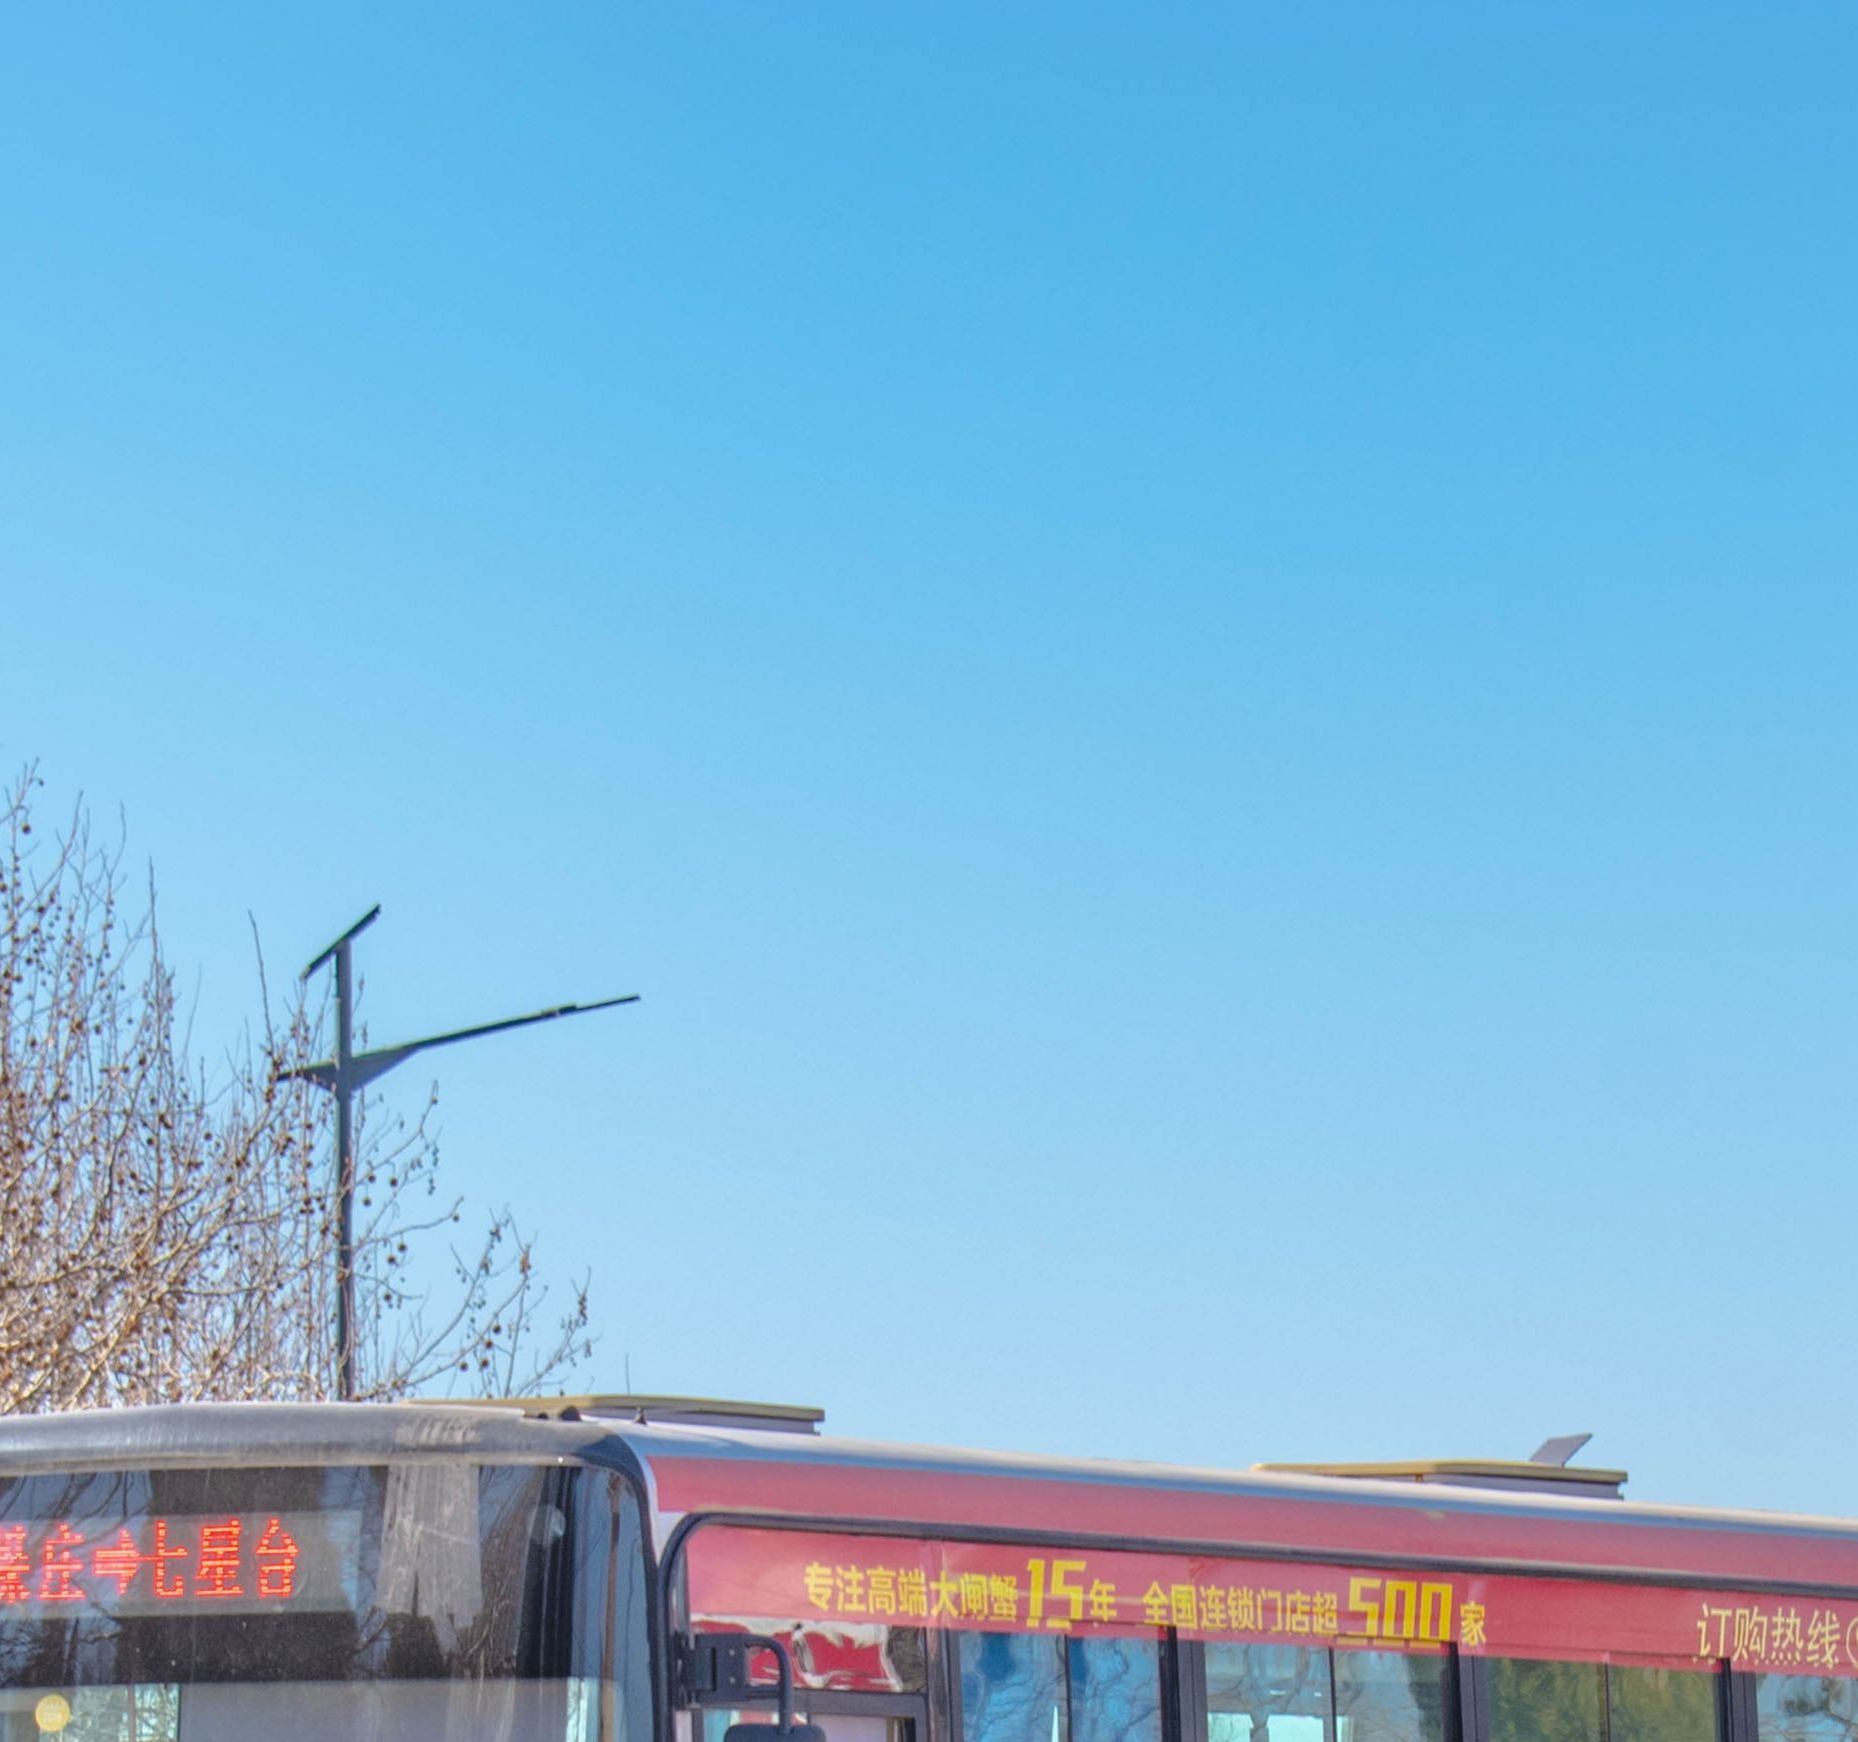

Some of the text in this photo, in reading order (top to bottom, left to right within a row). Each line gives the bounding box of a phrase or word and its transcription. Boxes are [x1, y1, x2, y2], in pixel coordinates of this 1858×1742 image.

[803, 1558, 1487, 1649] 专注高端大闸蟹15年 全国连锁门店超500家
[1696, 1603, 1841, 1669] 订购热线
